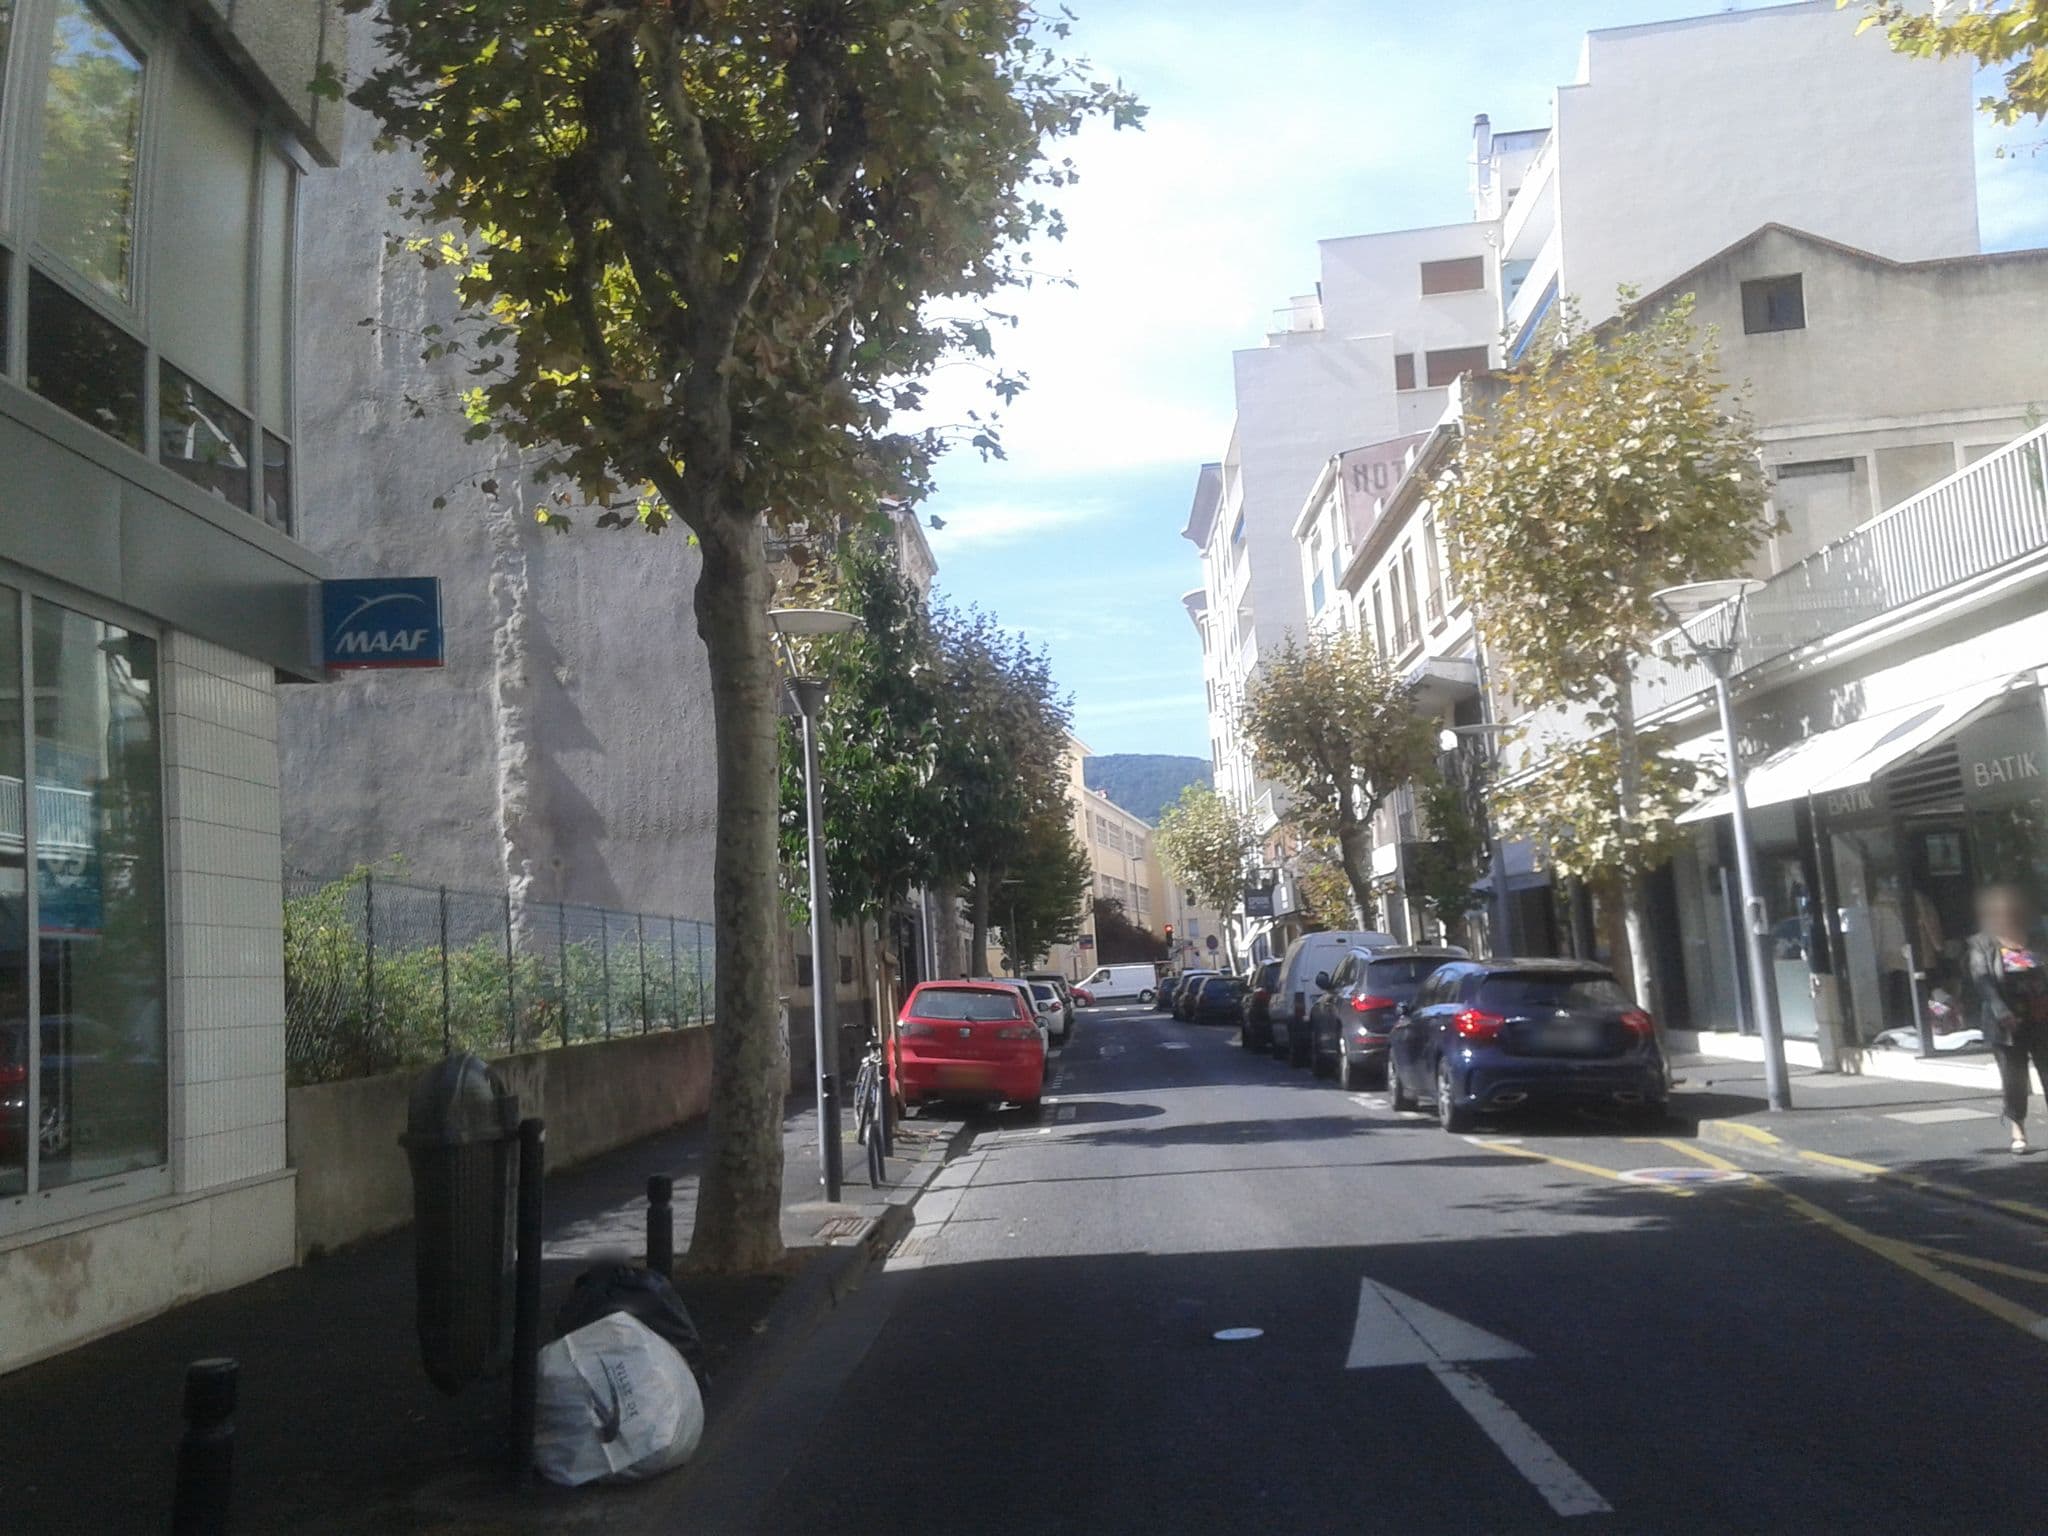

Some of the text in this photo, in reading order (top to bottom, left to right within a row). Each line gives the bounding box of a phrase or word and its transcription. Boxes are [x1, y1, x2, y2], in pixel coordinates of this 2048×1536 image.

[334, 629, 429, 655] MAAF
[1974, 752, 2040, 788] BATIK
[1827, 788, 1875, 816] BATIK
